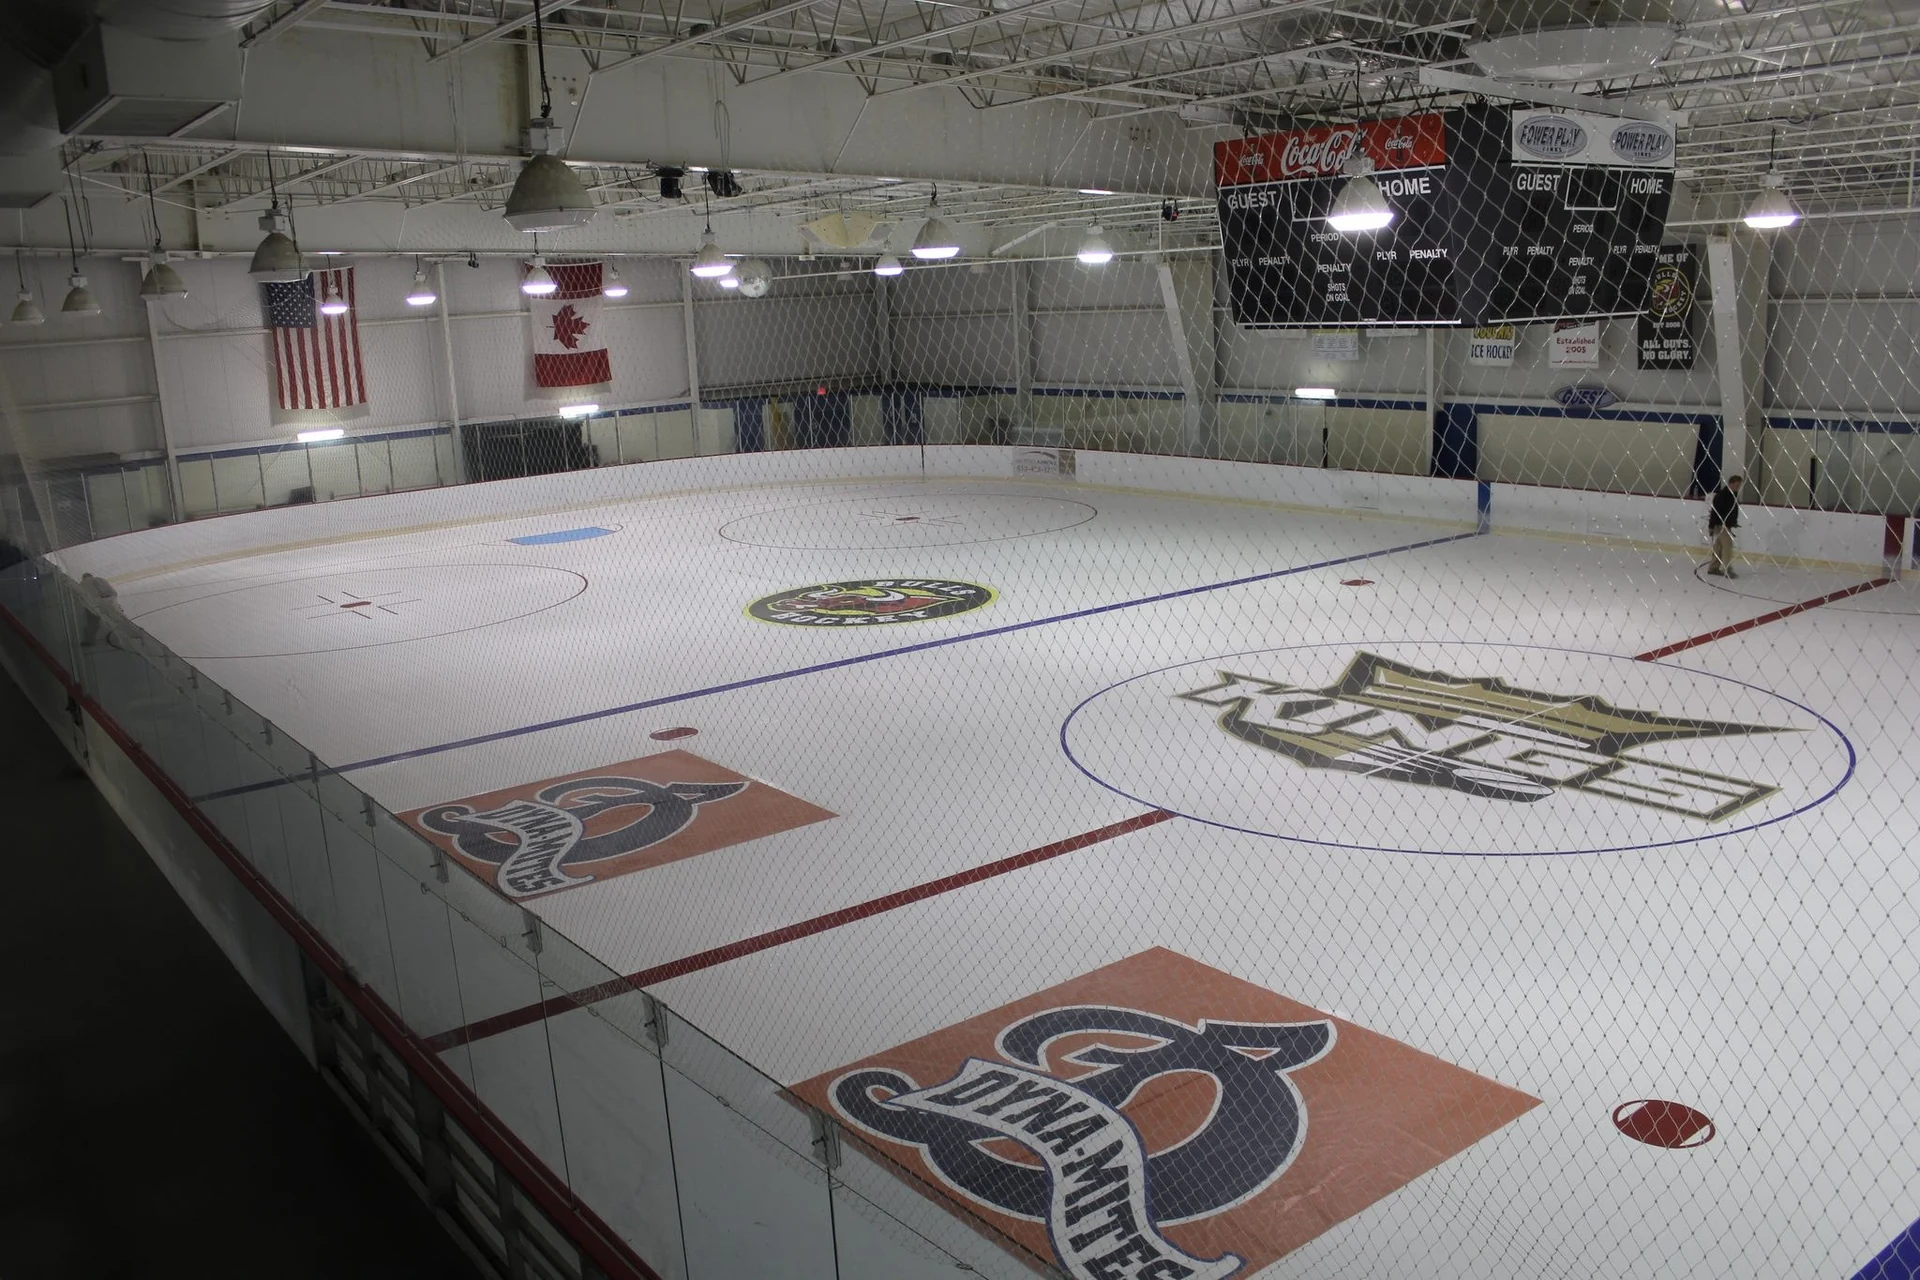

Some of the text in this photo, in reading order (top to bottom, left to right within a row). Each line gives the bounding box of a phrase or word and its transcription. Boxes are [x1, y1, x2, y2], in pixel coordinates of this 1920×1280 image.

[1520, 125, 1581, 148] POWER PLAY
[1615, 131, 1668, 152] POWER PLAY
[1281, 129, 1368, 176] Coca-Col
[1378, 177, 1431, 197] HOME
[1517, 173, 1560, 192] GUEST
[1631, 178, 1663, 194] HOME
[1228, 191, 1277, 210] GUEST
[1573, 224, 1594, 233] PERIOD
[1311, 233, 1339, 243] PERIOD
[1409, 249, 1448, 259] PENALTY
[1503, 246, 1518, 256] PLYR
[1527, 246, 1554, 256] PENALTY
[1614, 245, 1627, 254] PLYR
[1635, 245, 1659, 254] PENALTY
[1259, 256, 1291, 266] PENALTY
[1376, 251, 1397, 261] PLYR
[1676, 253, 1690, 263] OF
[1232, 258, 1249, 267] PLYR
[1569, 257, 1594, 266] PENALTY
[1317, 264, 1351, 273] PENALTY
[1327, 283, 1346, 292] SHOTS
[1326, 293, 1350, 302] ON GOAL
[1556, 337, 1596, 346] Established
[1642, 339, 1692, 349] ALL GUTS.
[1471, 344, 1513, 359] ICE HOCKEY
[1565, 346, 1587, 354] 2005
[1642, 350, 1692, 361] NO GLORY.
